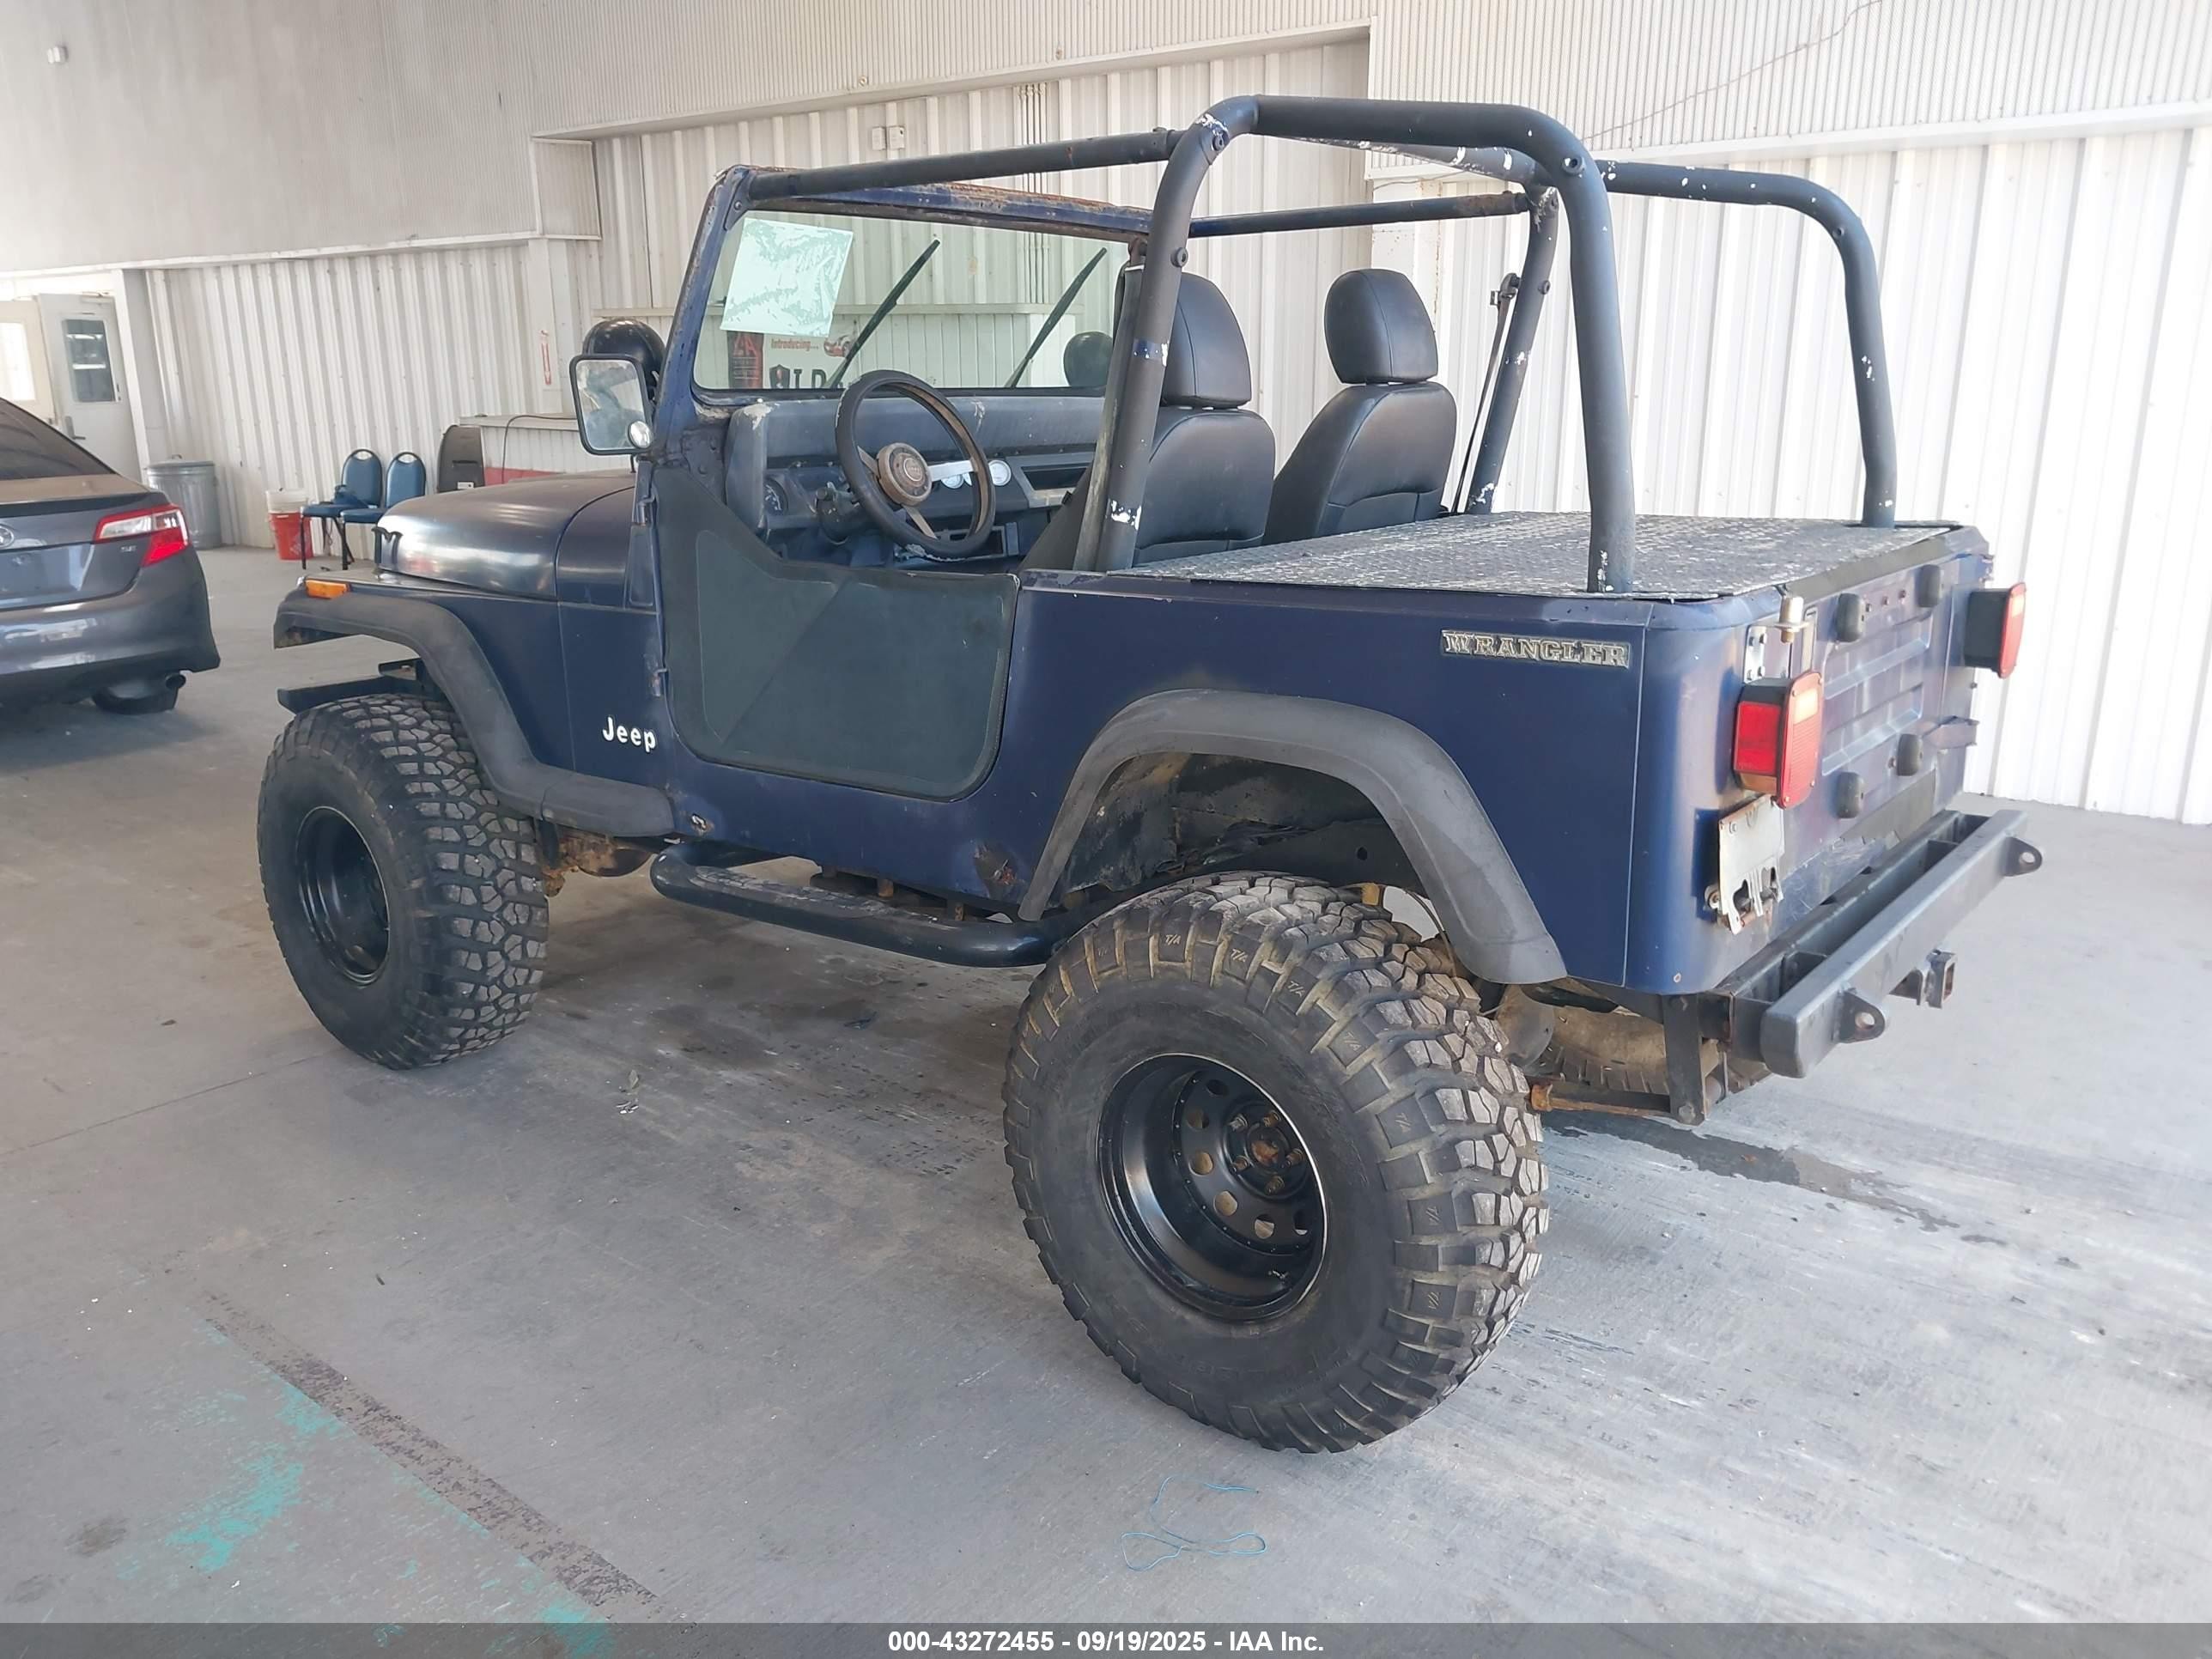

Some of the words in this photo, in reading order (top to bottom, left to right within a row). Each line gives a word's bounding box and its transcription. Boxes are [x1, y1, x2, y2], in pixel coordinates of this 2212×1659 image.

[1443, 632, 1628, 667] WRANGLER
[602, 716, 656, 753] Jeep
[1165, 934, 1182, 945] T/A
[1231, 948, 1248, 963] T/A
